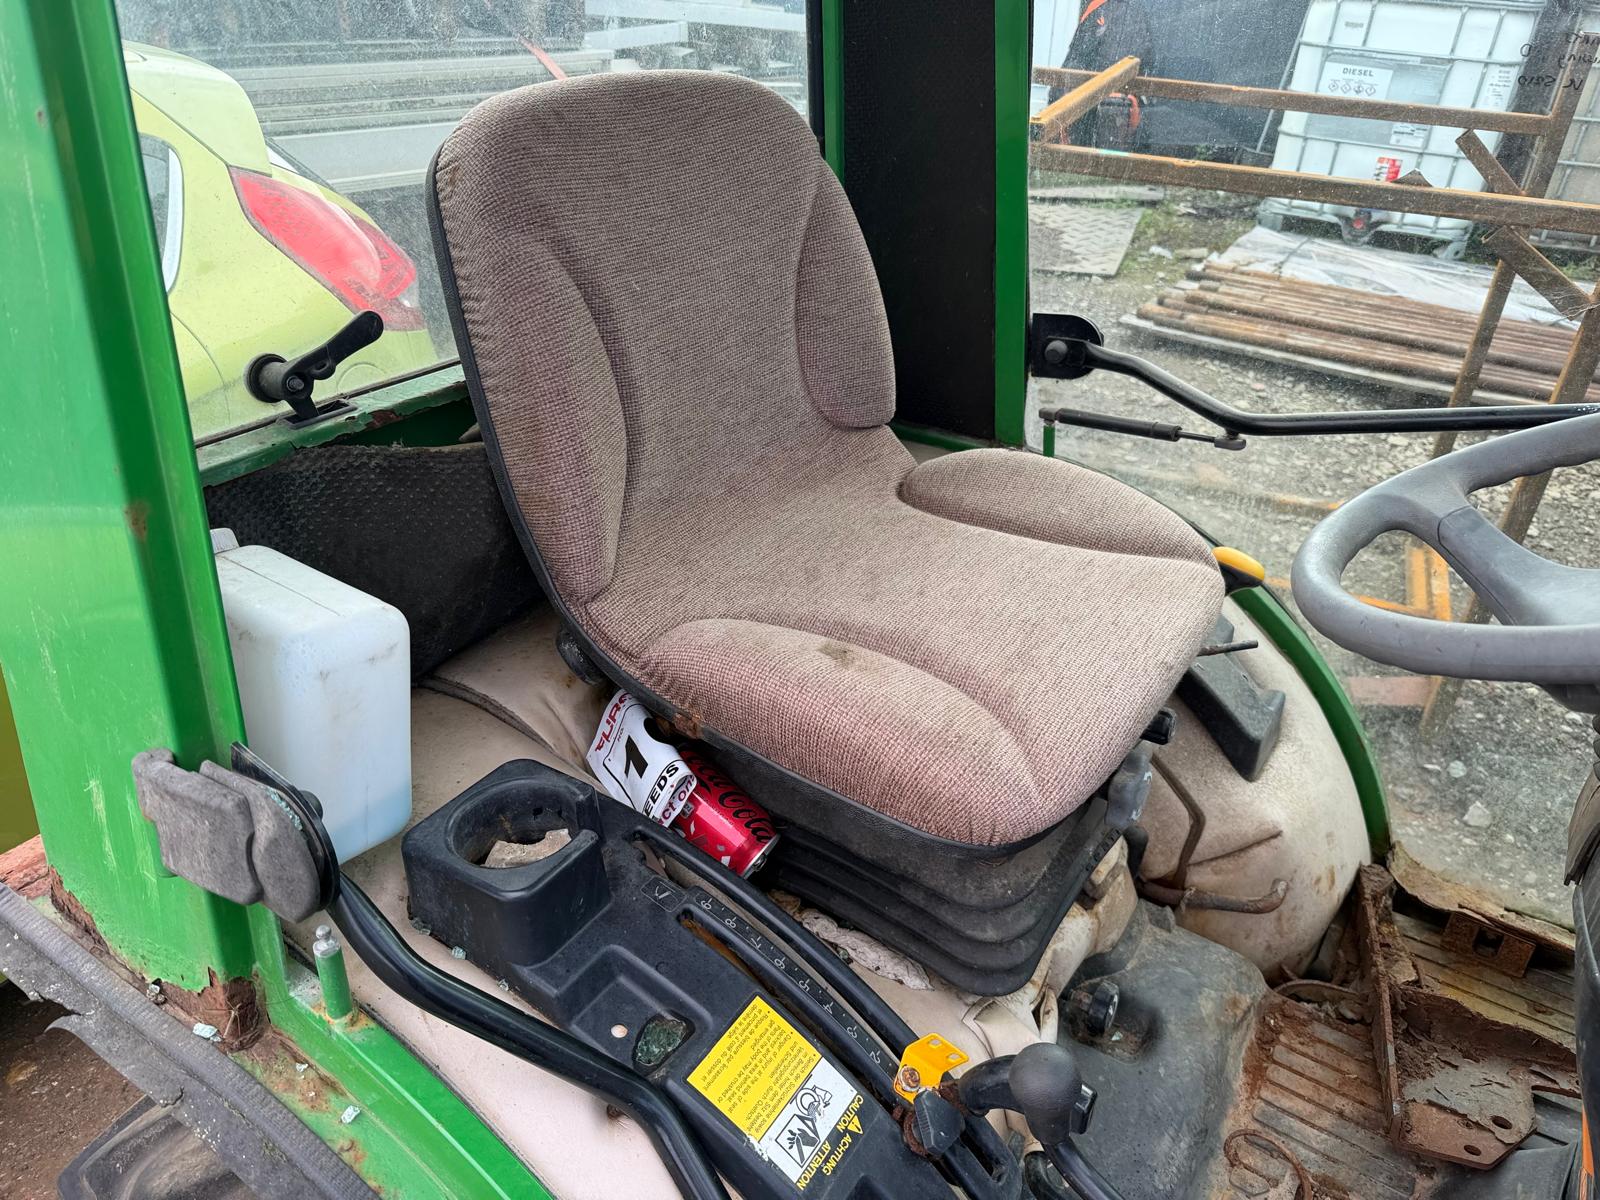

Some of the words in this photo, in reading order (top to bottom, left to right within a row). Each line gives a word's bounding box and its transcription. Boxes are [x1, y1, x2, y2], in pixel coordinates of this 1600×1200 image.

[1342, 68, 1374, 77] DIESEL
[624, 734, 648, 779] 1
[644, 763, 680, 818] EEDS
[725, 918, 736, 928] 8
[751, 938, 762, 948] 7
[799, 980, 810, 992] 5
[823, 1004, 833, 1014] 4
[847, 1026, 858, 1038] 3
[870, 1050, 880, 1064] 2
[836, 1094, 864, 1132] CAUTION
[822, 1133, 852, 1176] ACHTUNG
[796, 1140, 832, 1190] ATTENTION
